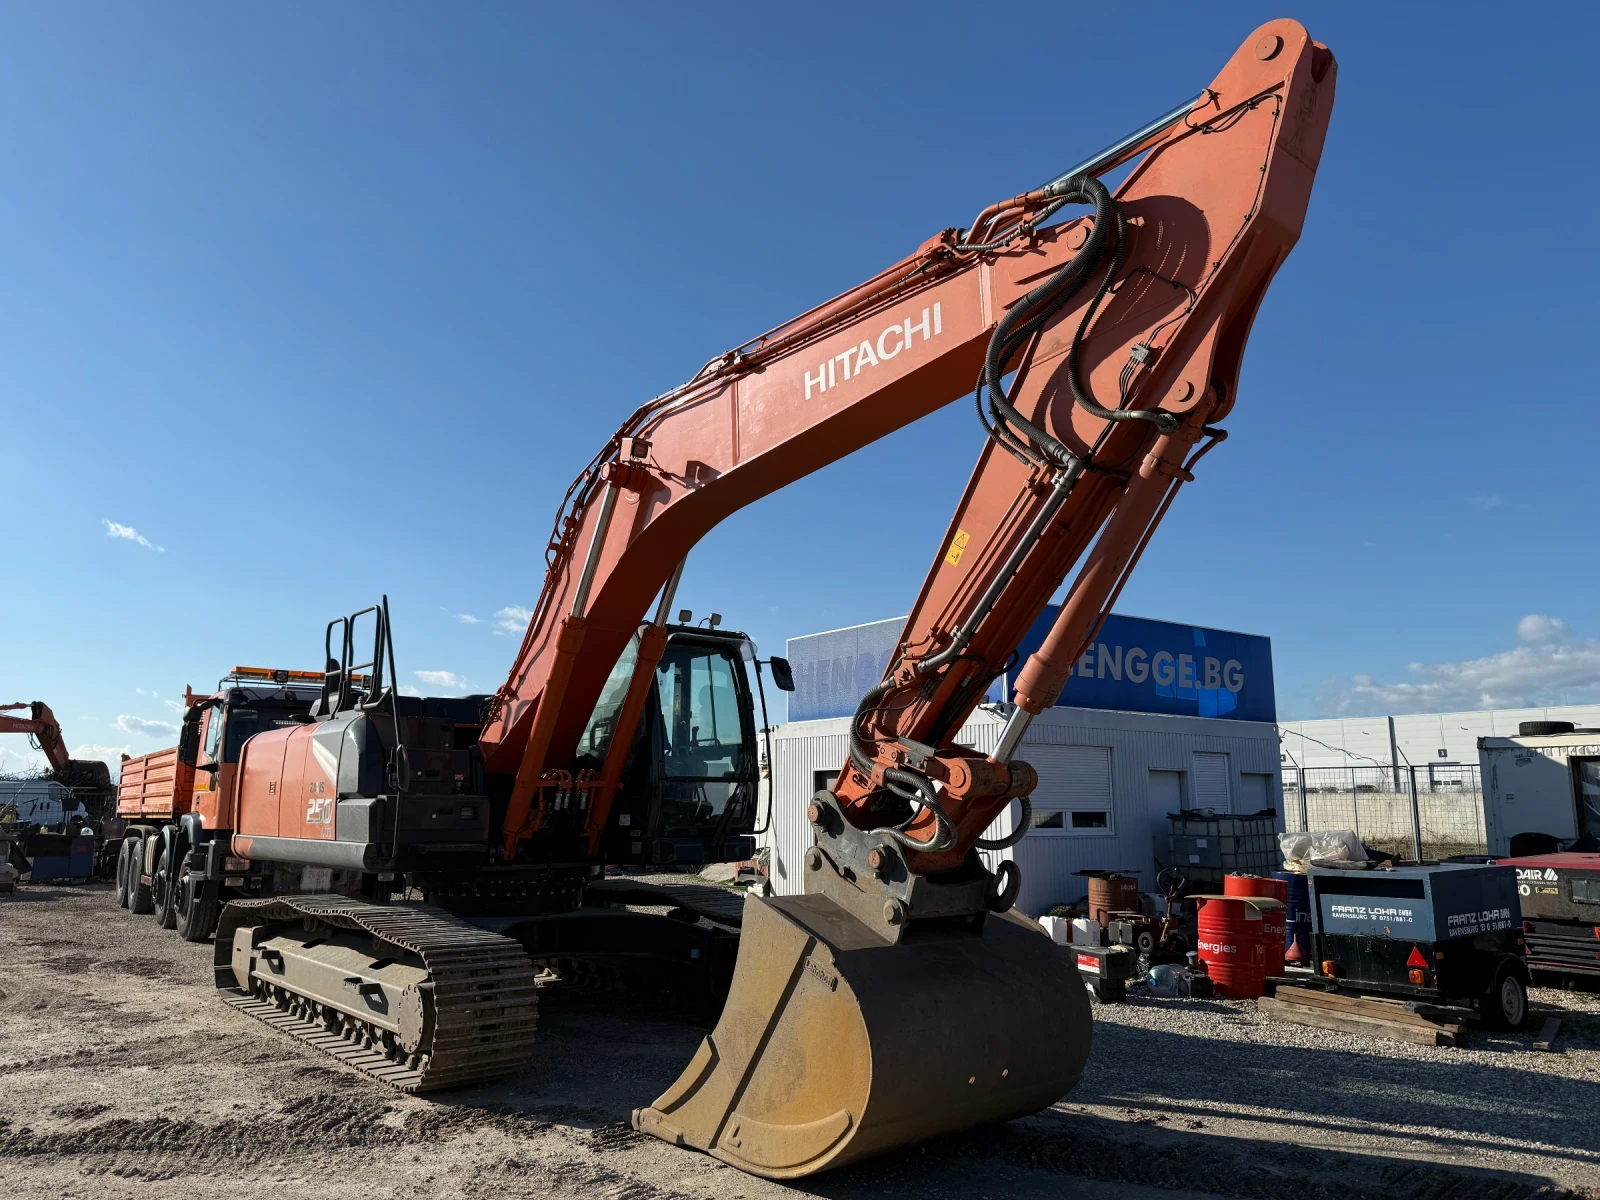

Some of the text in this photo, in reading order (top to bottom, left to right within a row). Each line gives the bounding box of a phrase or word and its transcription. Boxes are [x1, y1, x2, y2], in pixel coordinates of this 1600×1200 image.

[804, 302, 942, 400] HITACHI
[1067, 643, 1245, 693] ENGGE.BG
[306, 798, 333, 824] 250
[1331, 905, 1366, 914] FRANZ
[1368, 907, 1397, 916] LOHR
[1332, 912, 1368, 920] RAVENSBURG
[1447, 912, 1477, 926] FRANZ
[1478, 909, 1500, 922] LOHR
[1448, 924, 1479, 937] RAVENSBURG
